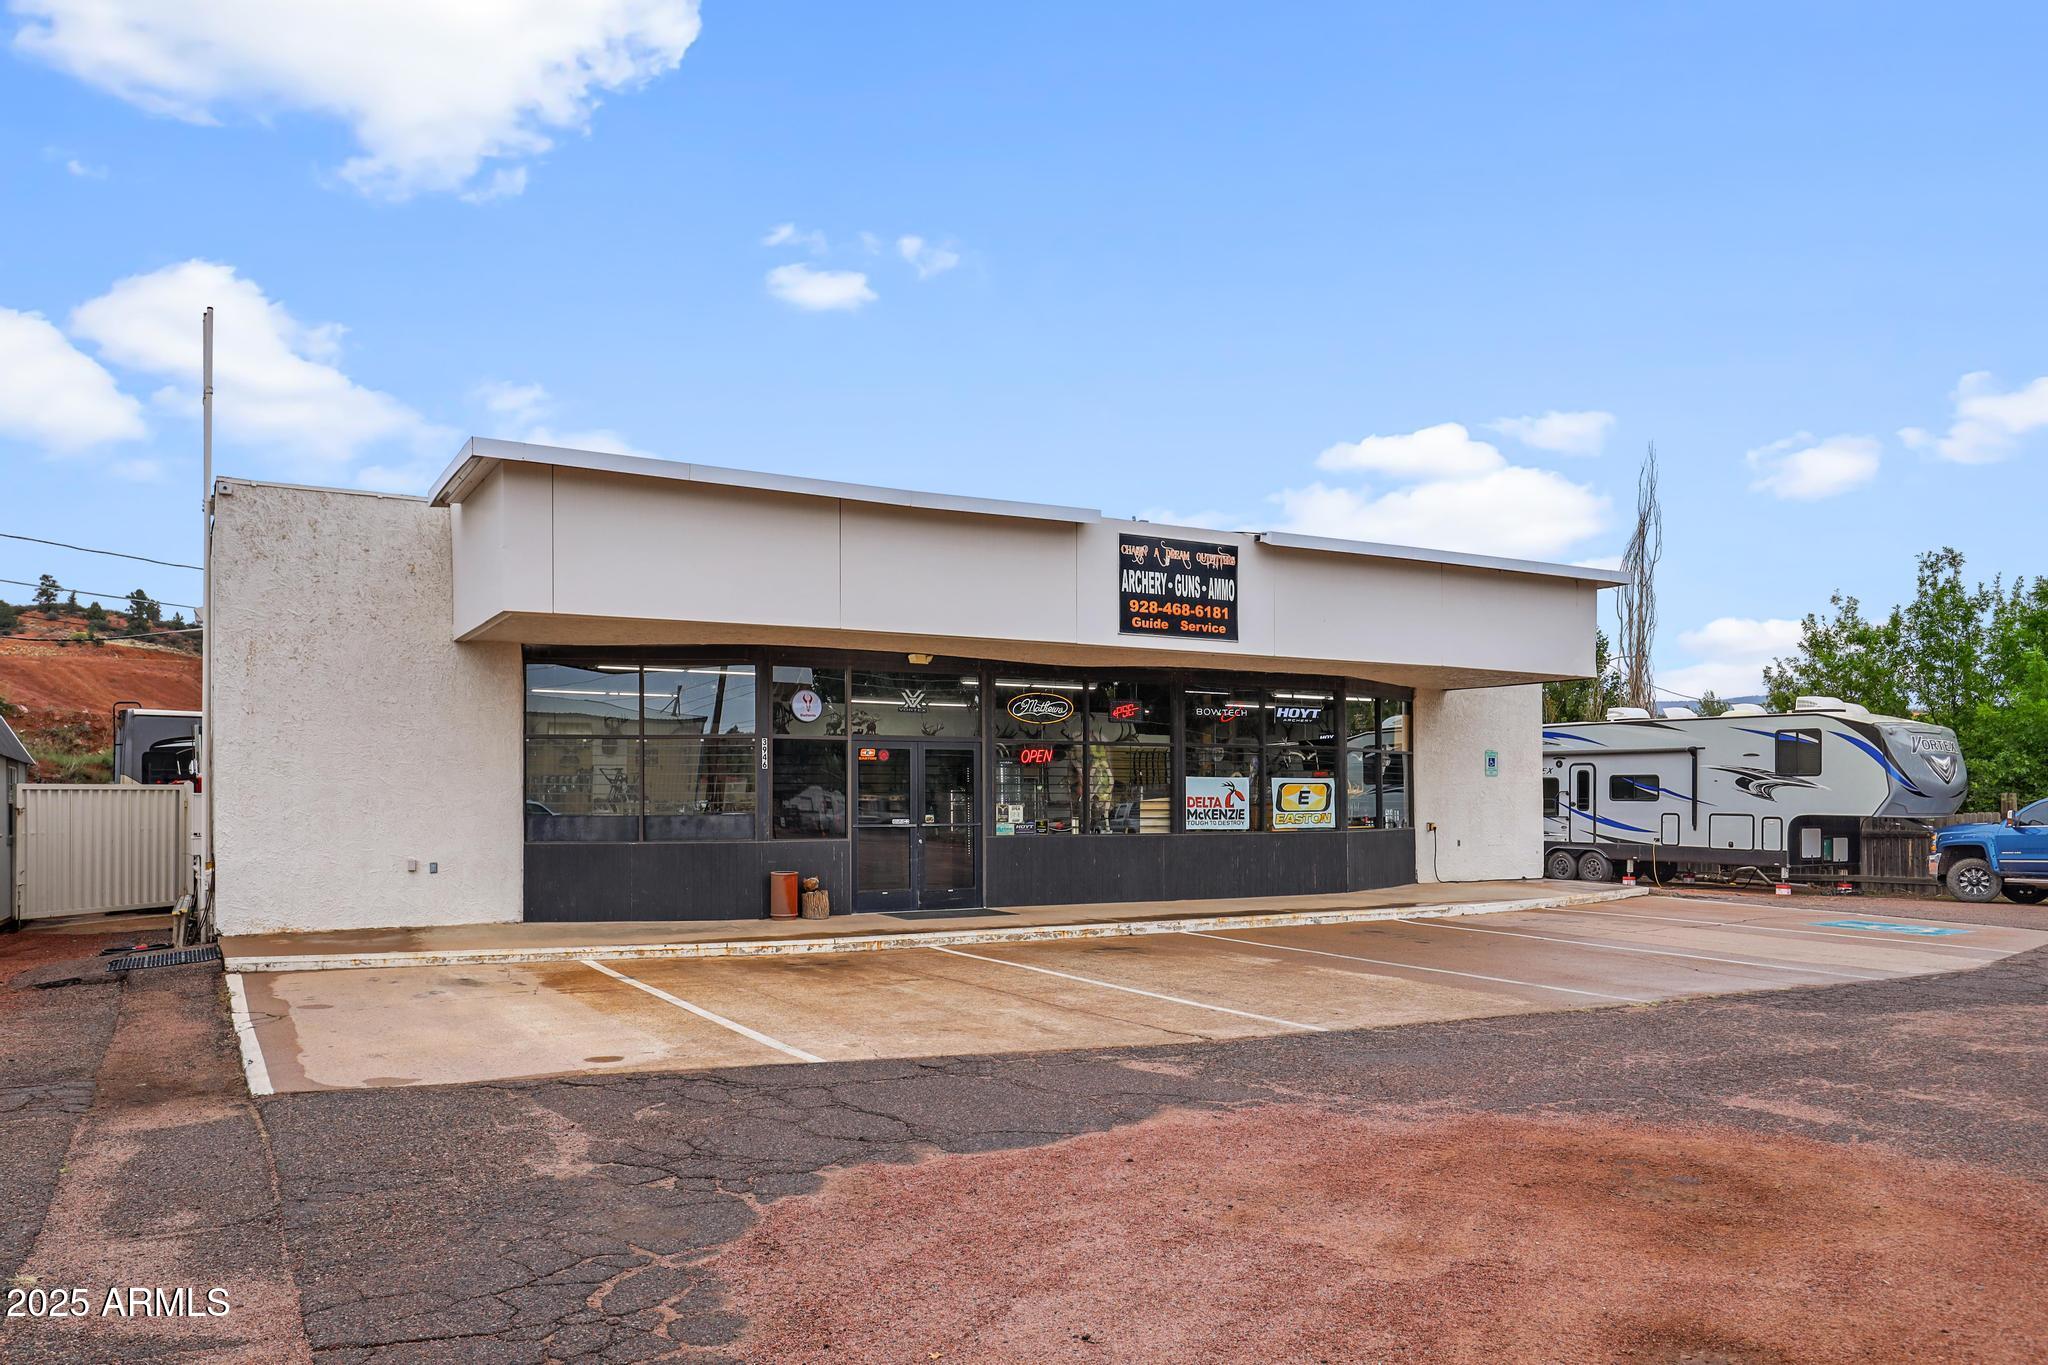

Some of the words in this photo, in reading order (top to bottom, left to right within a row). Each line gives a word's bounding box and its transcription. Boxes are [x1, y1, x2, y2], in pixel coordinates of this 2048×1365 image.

[1121, 569, 1168, 595] ARCHERY
[1174, 574, 1201, 598] GUNS
[1208, 578, 1235, 601] AMMO
[1129, 600, 1229, 619] 928-468-6181
[1131, 617, 1169, 629] Guide
[1180, 621, 1226, 633] Service
[1014, 698, 1068, 717] Mathews
[1196, 707, 1248, 717] BOWTECH
[1276, 707, 1321, 718] HOYT
[1021, 750, 1053, 763] OPEN
[1187, 797, 1222, 808] DELTA
[1187, 809, 1245, 820] McKENZIE
[1275, 813, 1332, 825] EASTON
